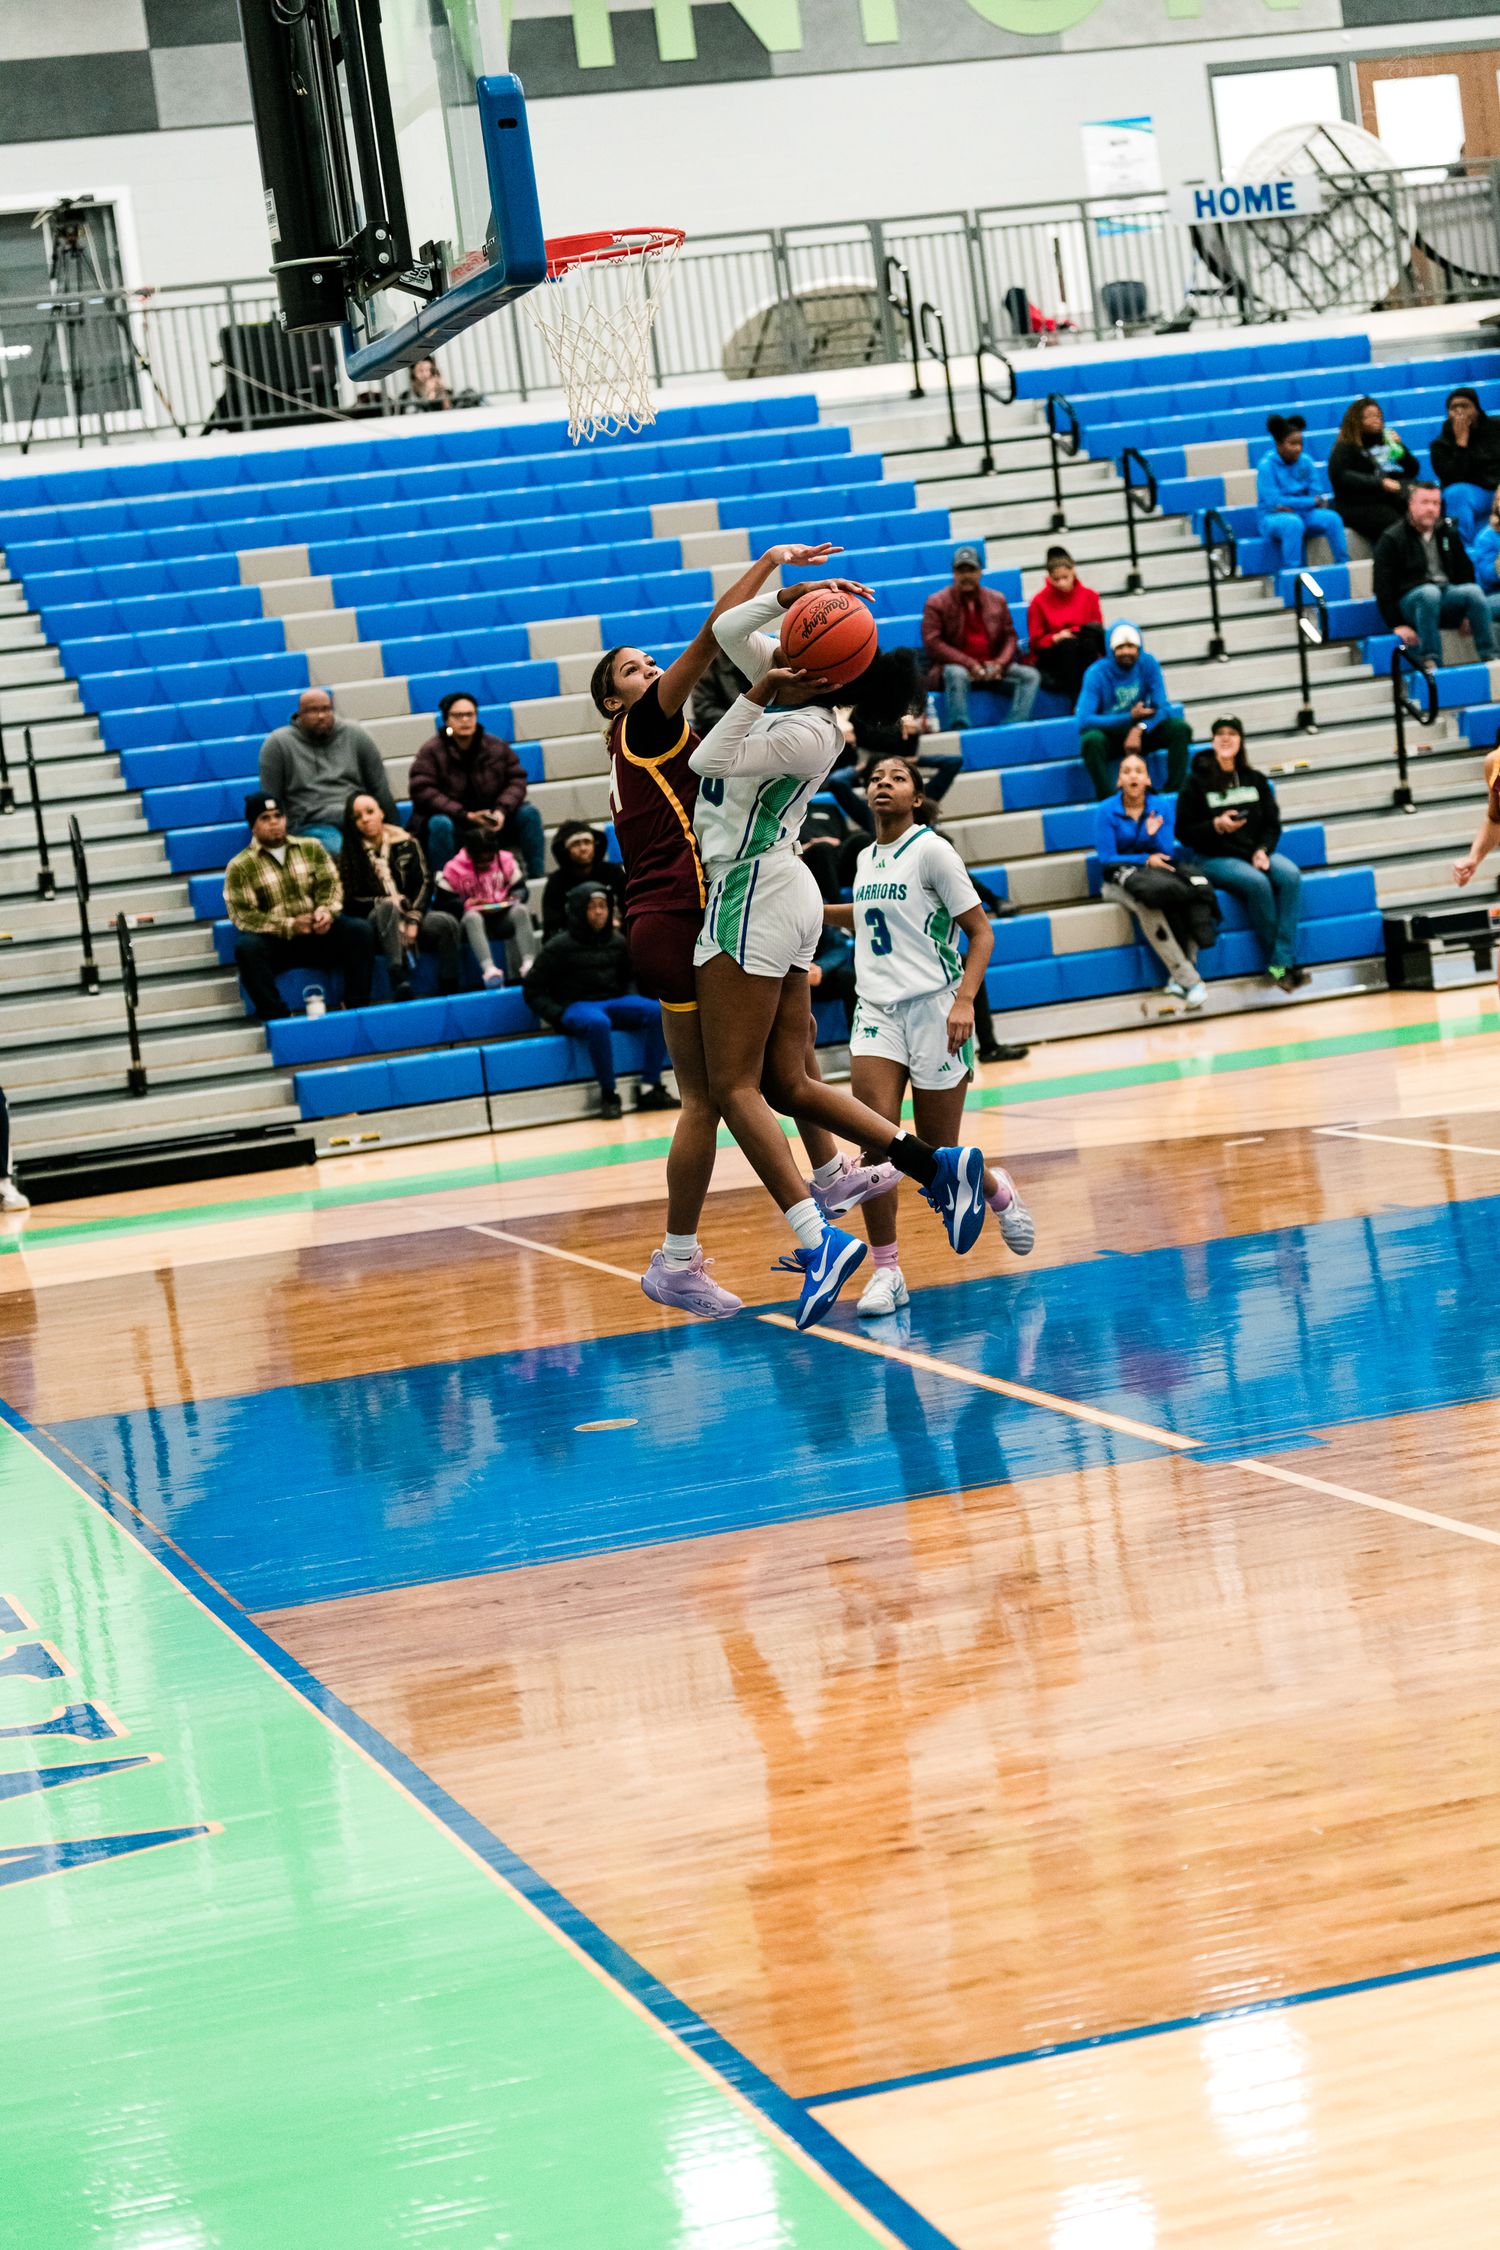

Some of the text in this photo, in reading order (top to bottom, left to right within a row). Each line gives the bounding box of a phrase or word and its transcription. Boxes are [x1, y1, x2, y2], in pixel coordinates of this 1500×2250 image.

[1194, 181, 1296, 218] HOME
[801, 596, 850, 640] Rawlings
[864, 907, 893, 956] 3
